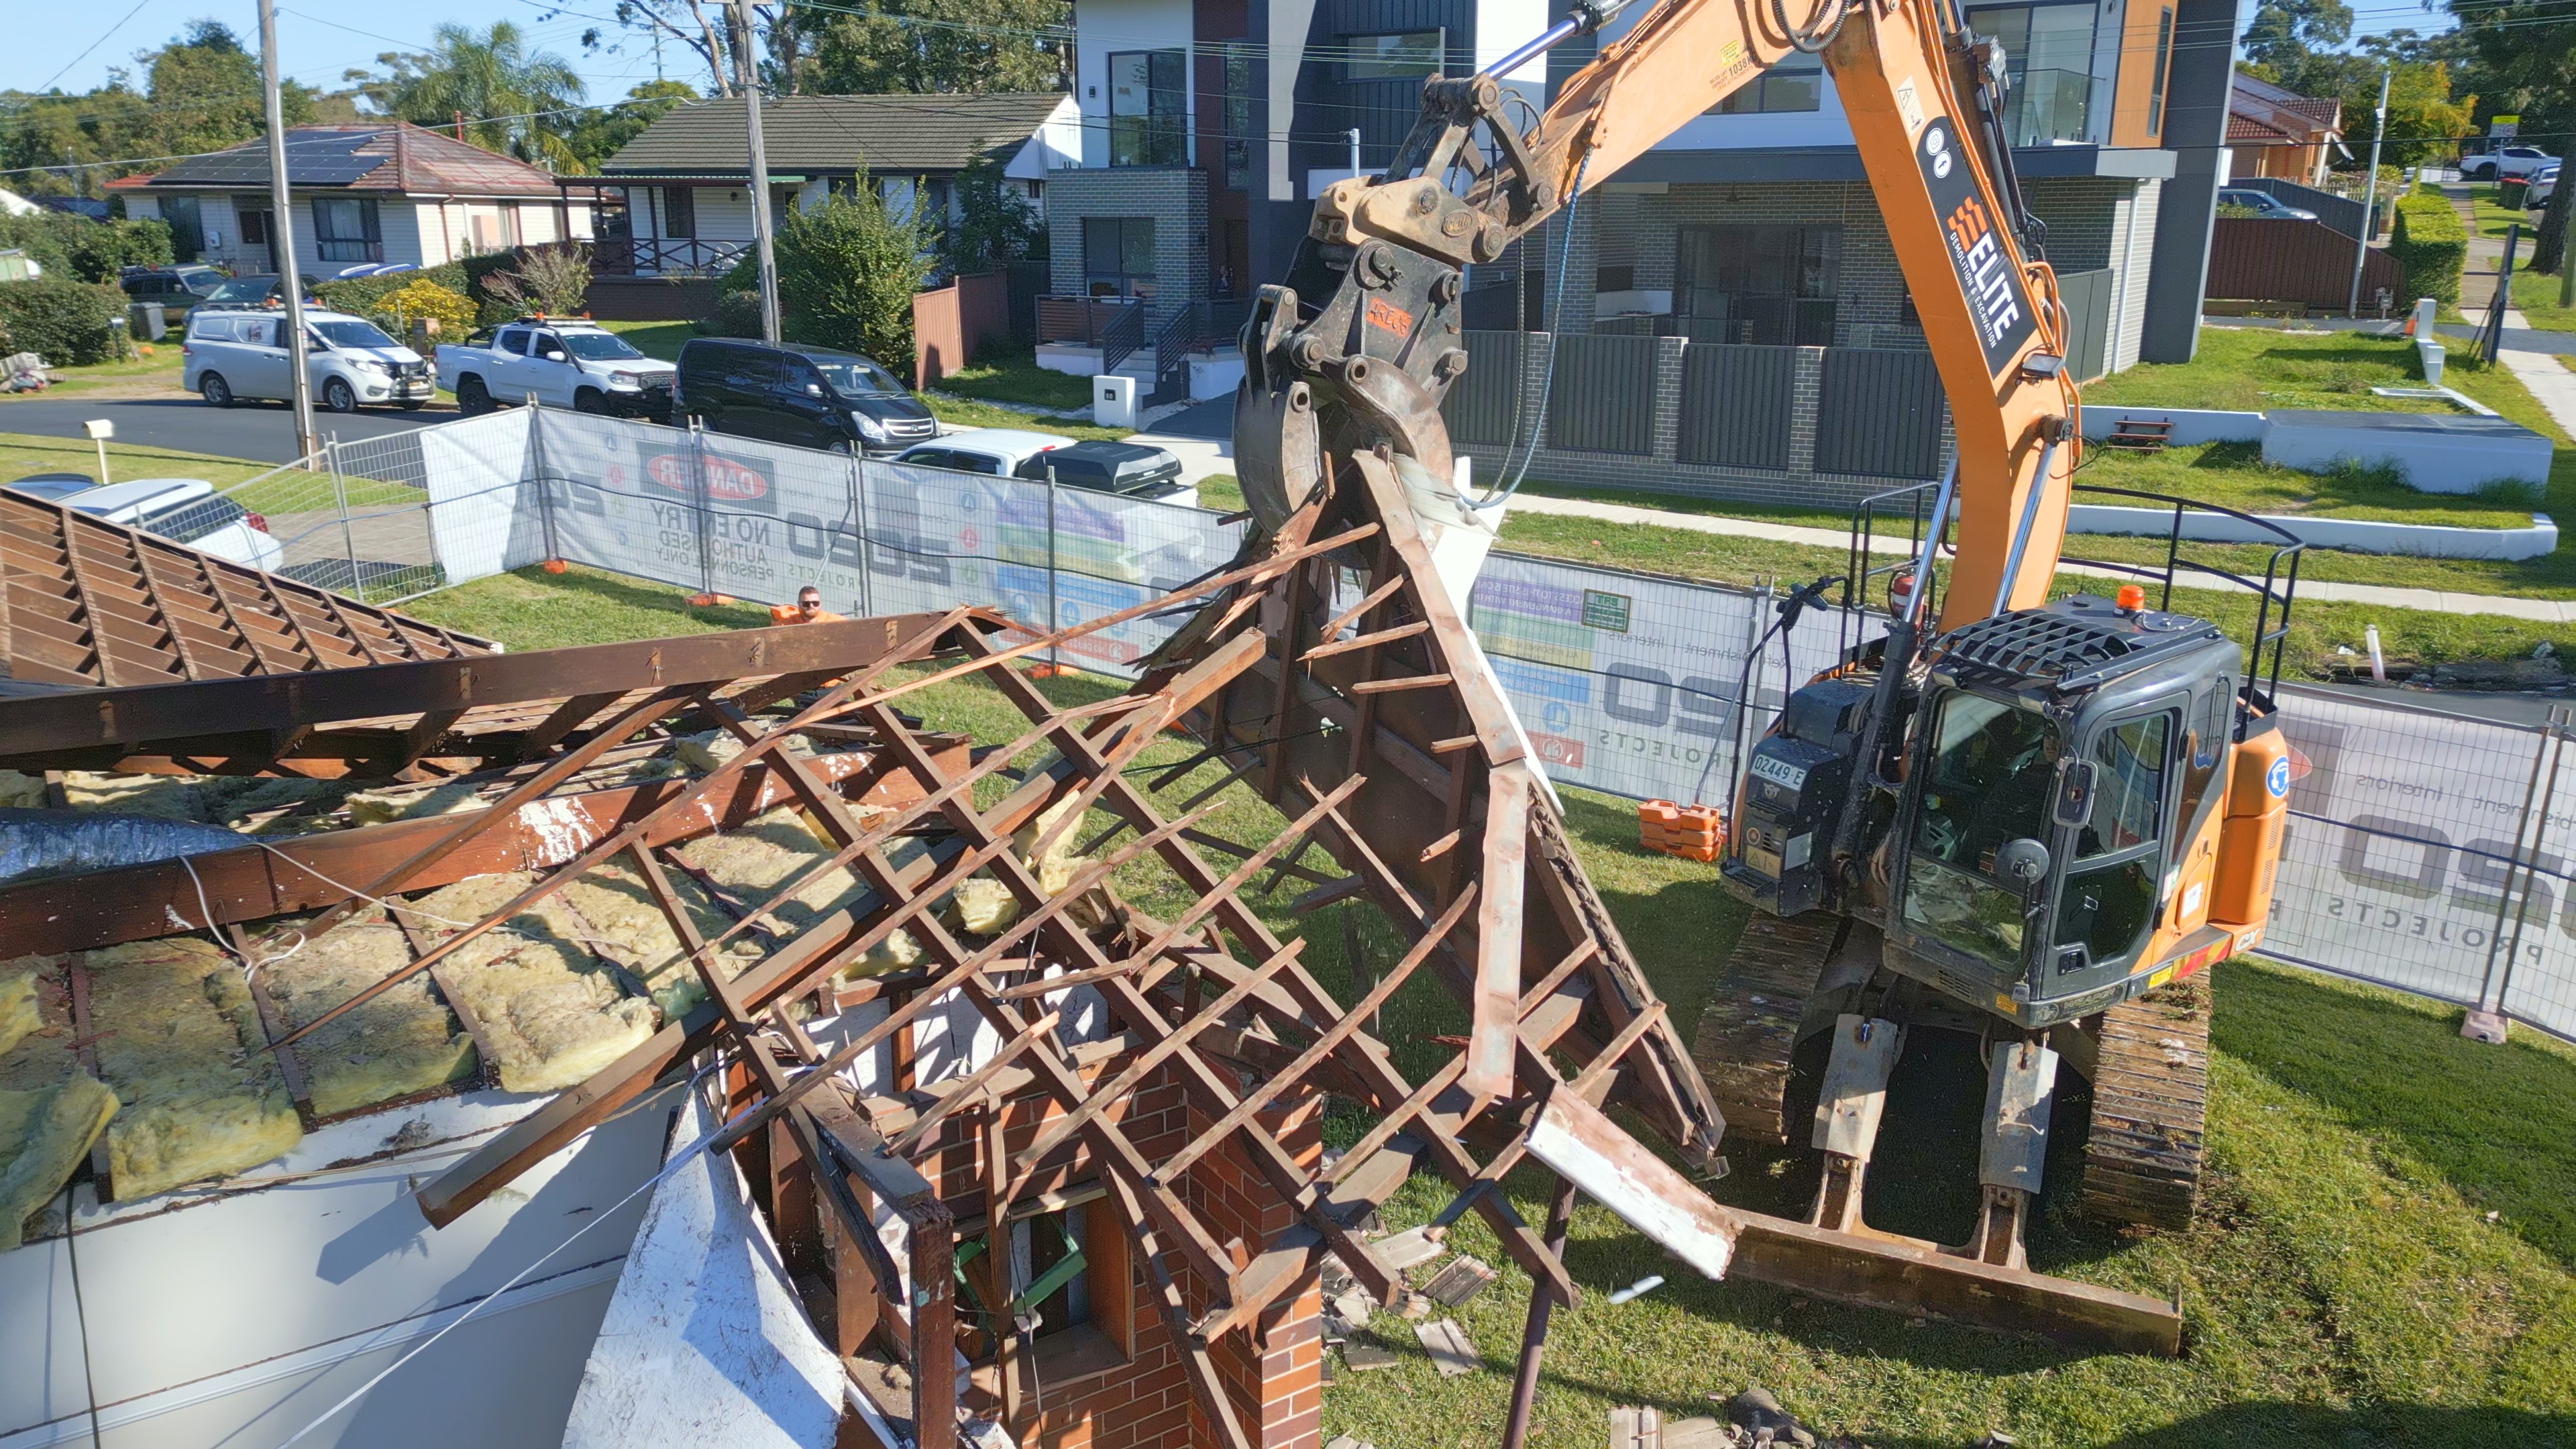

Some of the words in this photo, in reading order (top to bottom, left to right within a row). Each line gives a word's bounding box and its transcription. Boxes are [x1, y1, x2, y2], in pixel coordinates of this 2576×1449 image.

[1949, 231, 1975, 287] DEMOLITION
[1974, 295, 1997, 349] EXCAVATION
[1967, 231, 2019, 340] ELITE
[1595, 594, 1618, 607] TFS
[2235, 927, 2261, 952] CX
